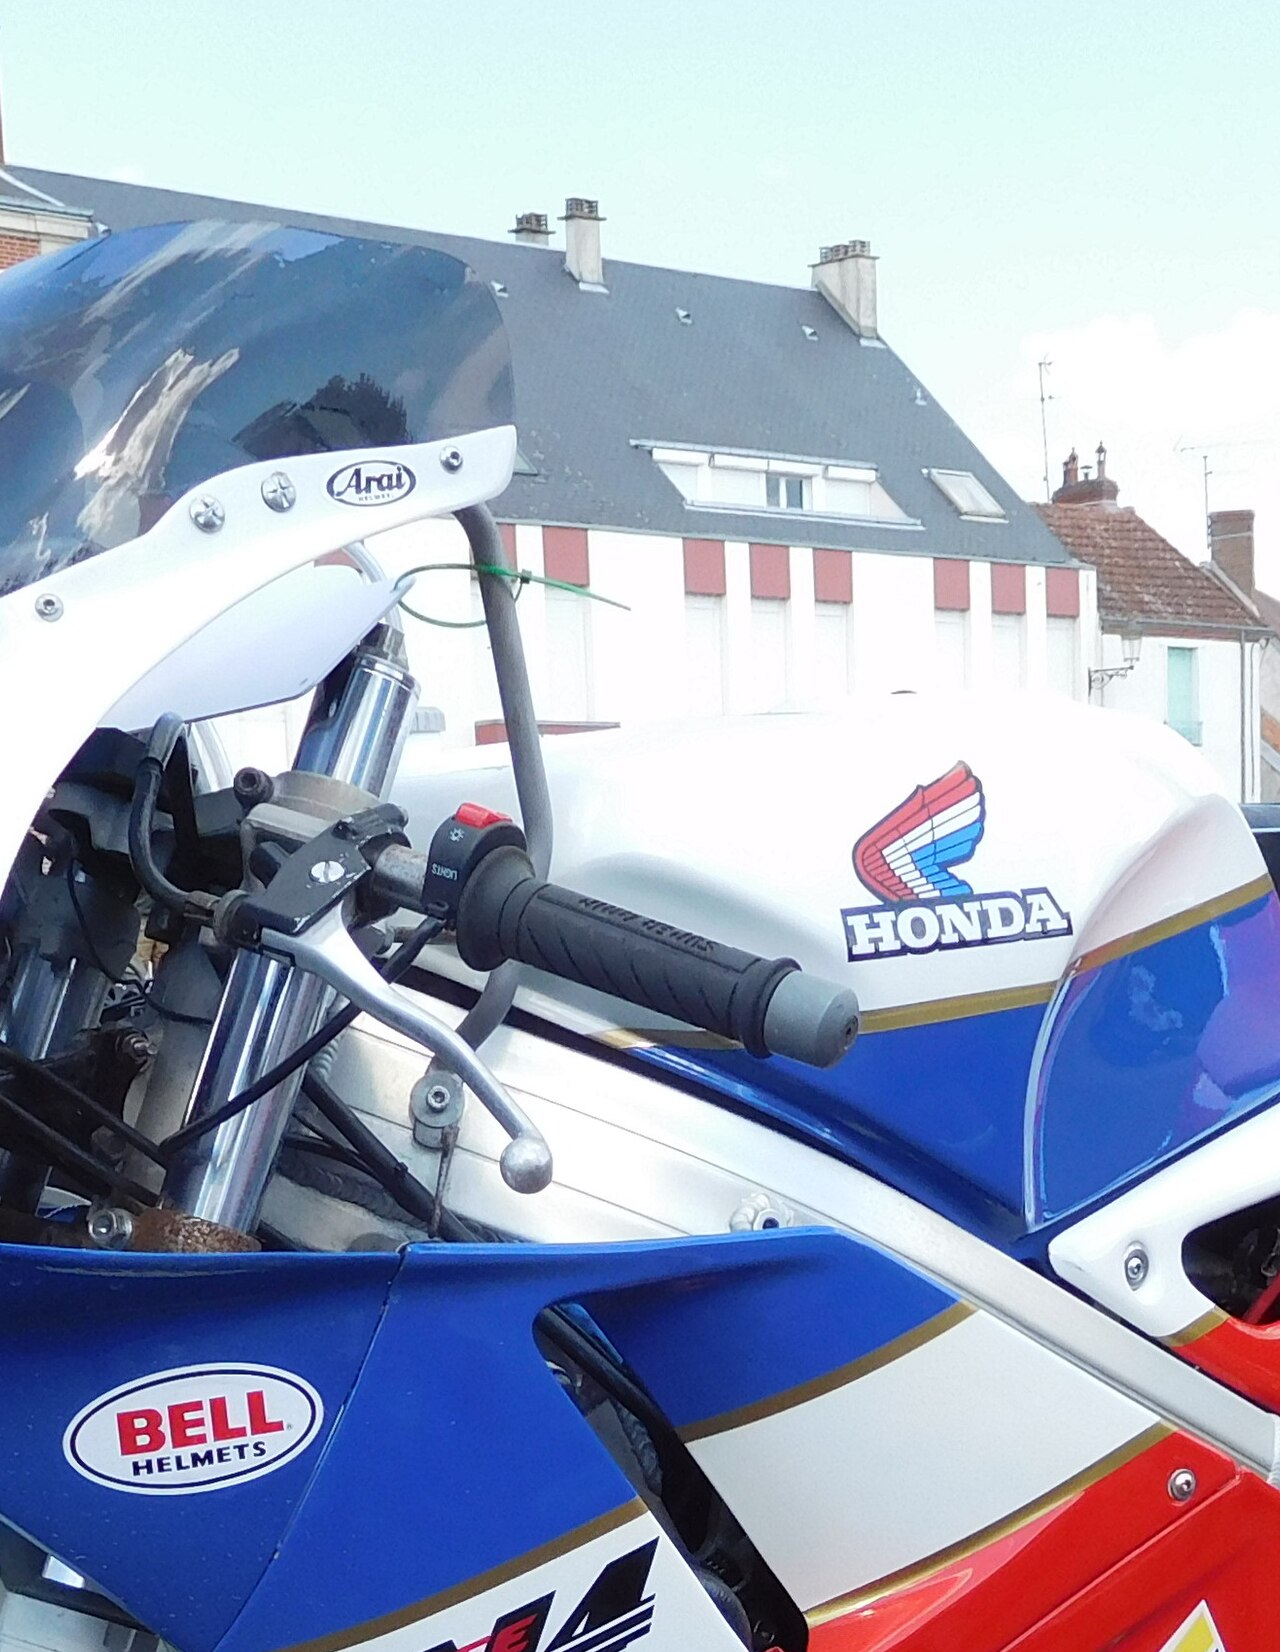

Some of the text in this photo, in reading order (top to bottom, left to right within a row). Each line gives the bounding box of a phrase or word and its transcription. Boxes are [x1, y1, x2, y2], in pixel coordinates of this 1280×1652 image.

[336, 466, 406, 497] Arai
[843, 888, 1071, 961] HONDA
[117, 1390, 284, 1455] BELL
[132, 1441, 266, 1476] HELMETS
